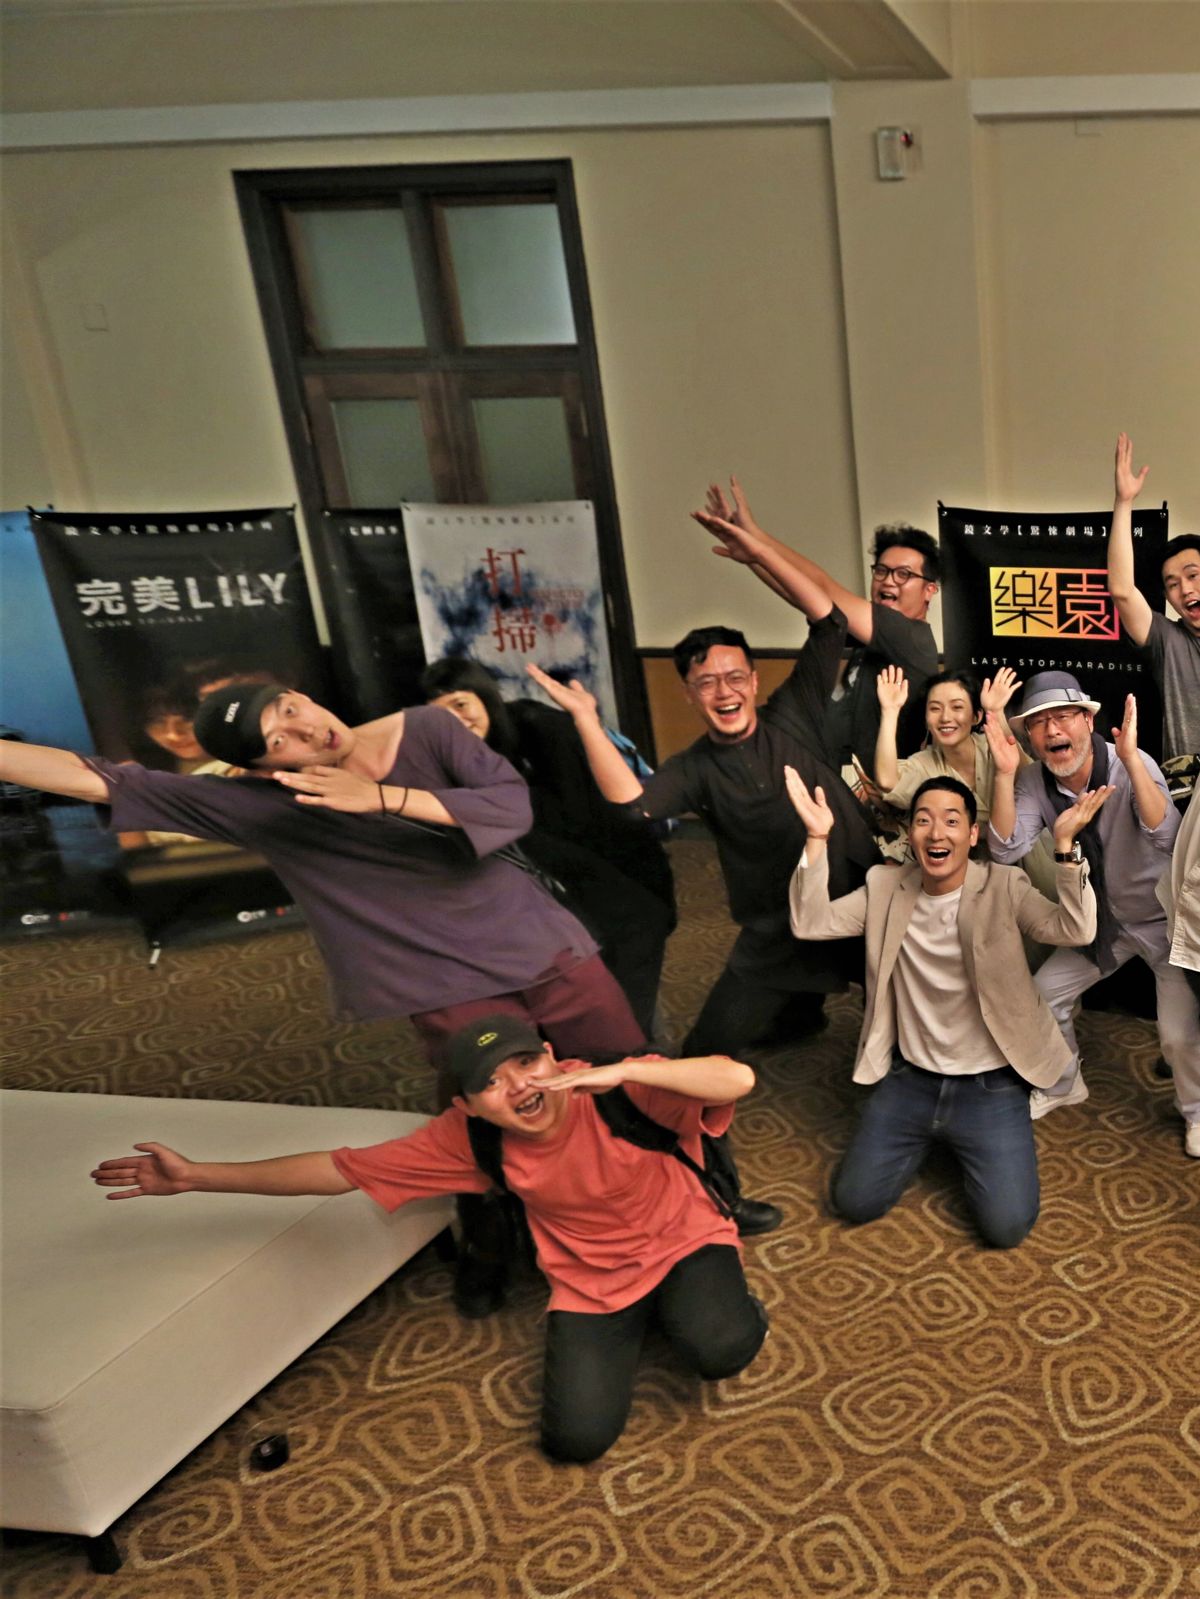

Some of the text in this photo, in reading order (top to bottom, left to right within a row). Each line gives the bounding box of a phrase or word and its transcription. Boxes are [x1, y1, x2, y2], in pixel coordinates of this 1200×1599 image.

[964, 524, 1143, 538] 鏡文學【驚悚劇場】列
[76, 572, 287, 617] 完美LILY
[480, 547, 537, 653] 打掃
[990, 567, 1120, 640] 樂園
[971, 657, 1008, 666] LAST
